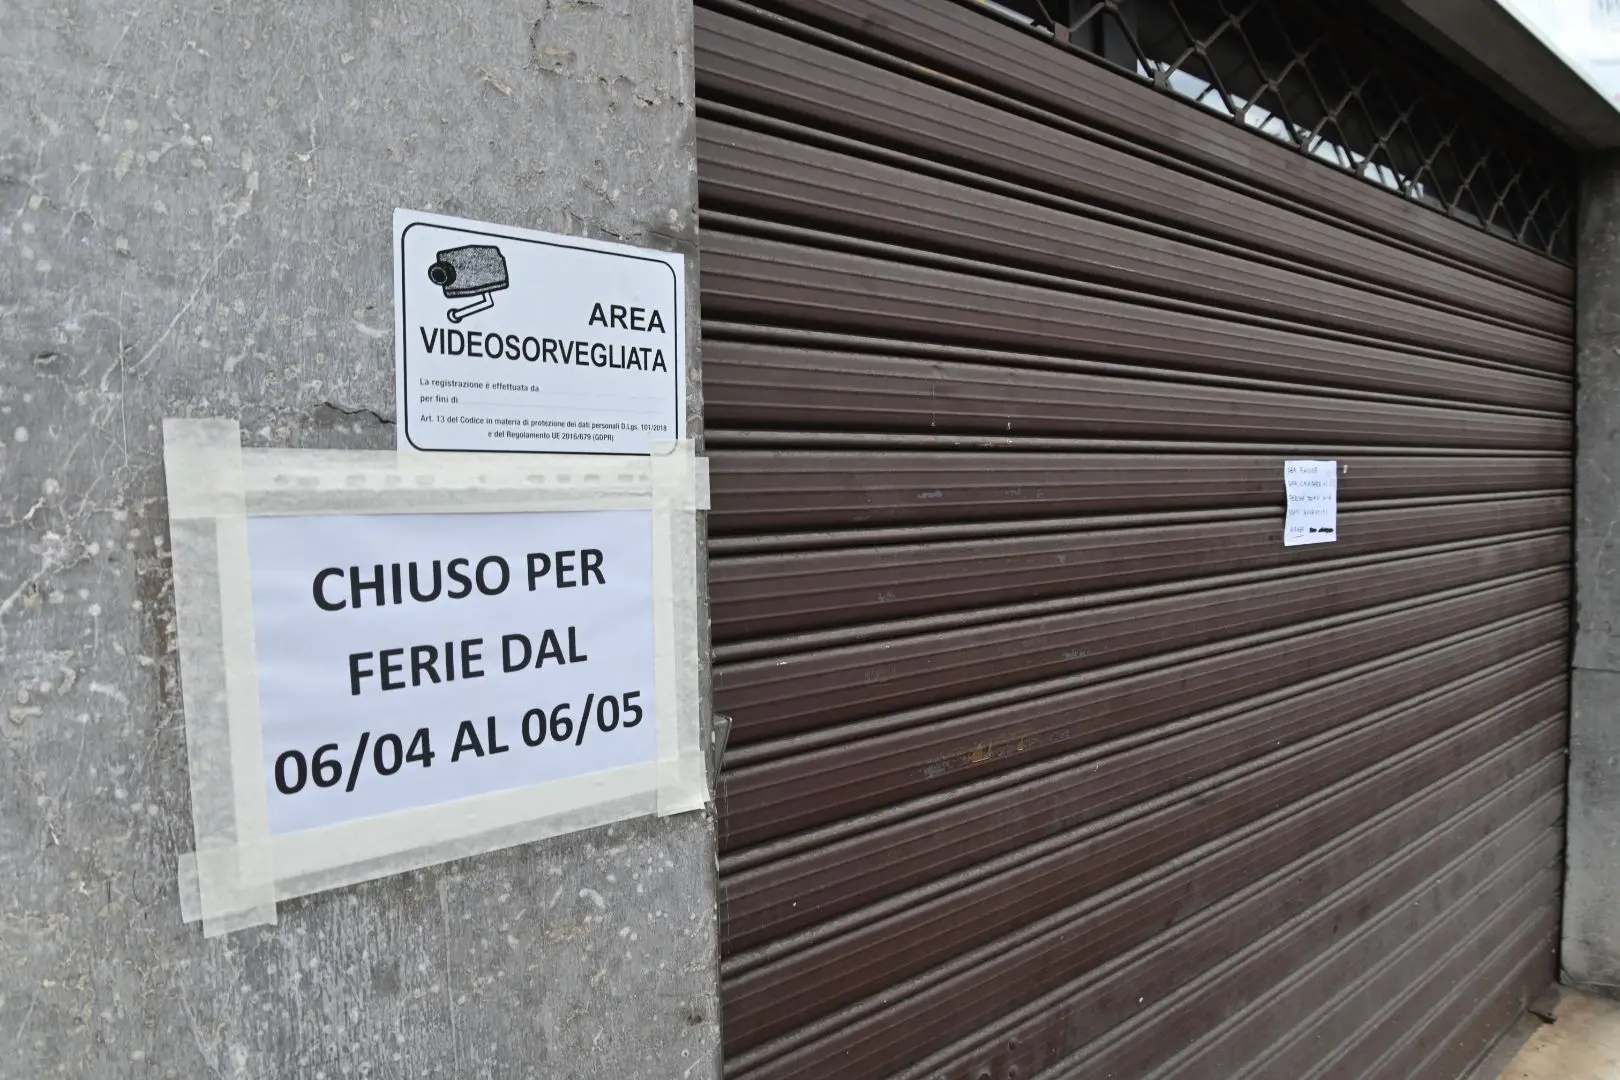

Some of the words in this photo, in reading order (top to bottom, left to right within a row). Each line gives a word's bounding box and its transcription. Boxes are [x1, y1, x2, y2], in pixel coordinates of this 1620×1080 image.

[589, 303, 665, 333] AREA
[420, 327, 668, 373] VIDEOSORVEGLIATA
[419, 378, 430, 386] La
[431, 378, 483, 389] registrazione
[492, 382, 528, 392] effettuata
[530, 384, 540, 392] da
[420, 395, 433, 404] per
[436, 395, 449, 403] fini
[451, 395, 459, 404] di
[420, 414, 433, 422] Art.
[436, 415, 445, 423] 13
[446, 415, 458, 424] del
[460, 416, 484, 425] Codice
[486, 417, 493, 425] in
[494, 417, 521, 426] materia
[522, 418, 530, 427] di
[530, 419, 565, 429] protezione
[566, 421, 577, 429] dei
[578, 421, 590, 429] dati
[591, 421, 620, 431] personali
[494, 430, 505, 438] del
[506, 430, 550, 440] Regolamento
[551, 432, 560, 440] UE
[592, 433, 614, 442] (GDPR)
[313, 556, 510, 612] CHIUSO
[527, 549, 605, 592] PER
[349, 639, 484, 695] FERIE
[502, 627, 588, 673] DAL
[275, 728, 436, 794] 06/04
[451, 716, 509, 762] AL
[522, 691, 643, 747] 06/05
